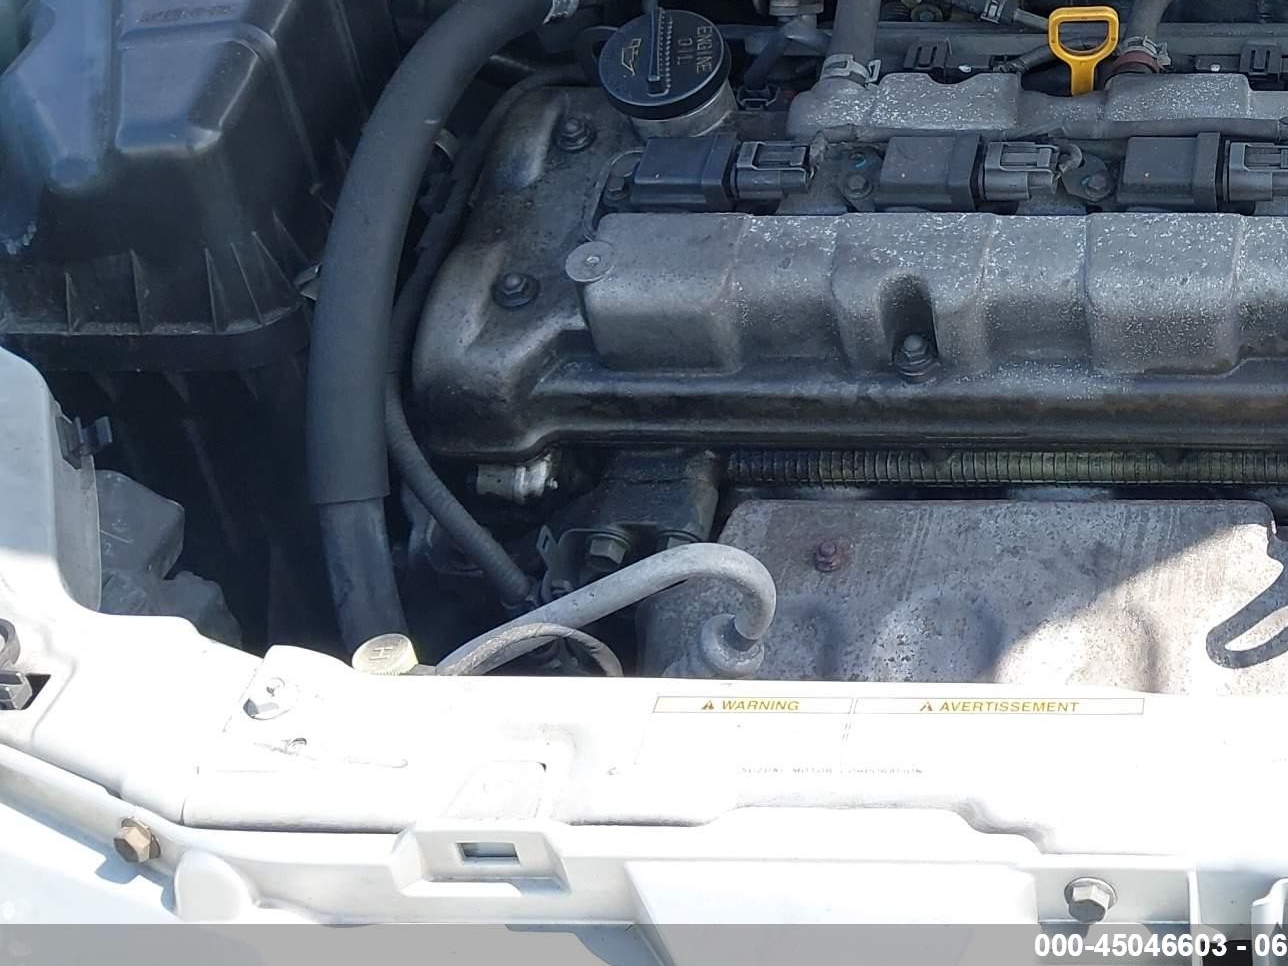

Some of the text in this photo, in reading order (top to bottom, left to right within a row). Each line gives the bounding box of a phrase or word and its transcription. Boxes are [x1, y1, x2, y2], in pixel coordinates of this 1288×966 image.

[677, 37, 694, 66] OIL
[696, 25, 713, 75] ENGINE
[721, 699, 1081, 713] WARNING AVERTISSEMENT
